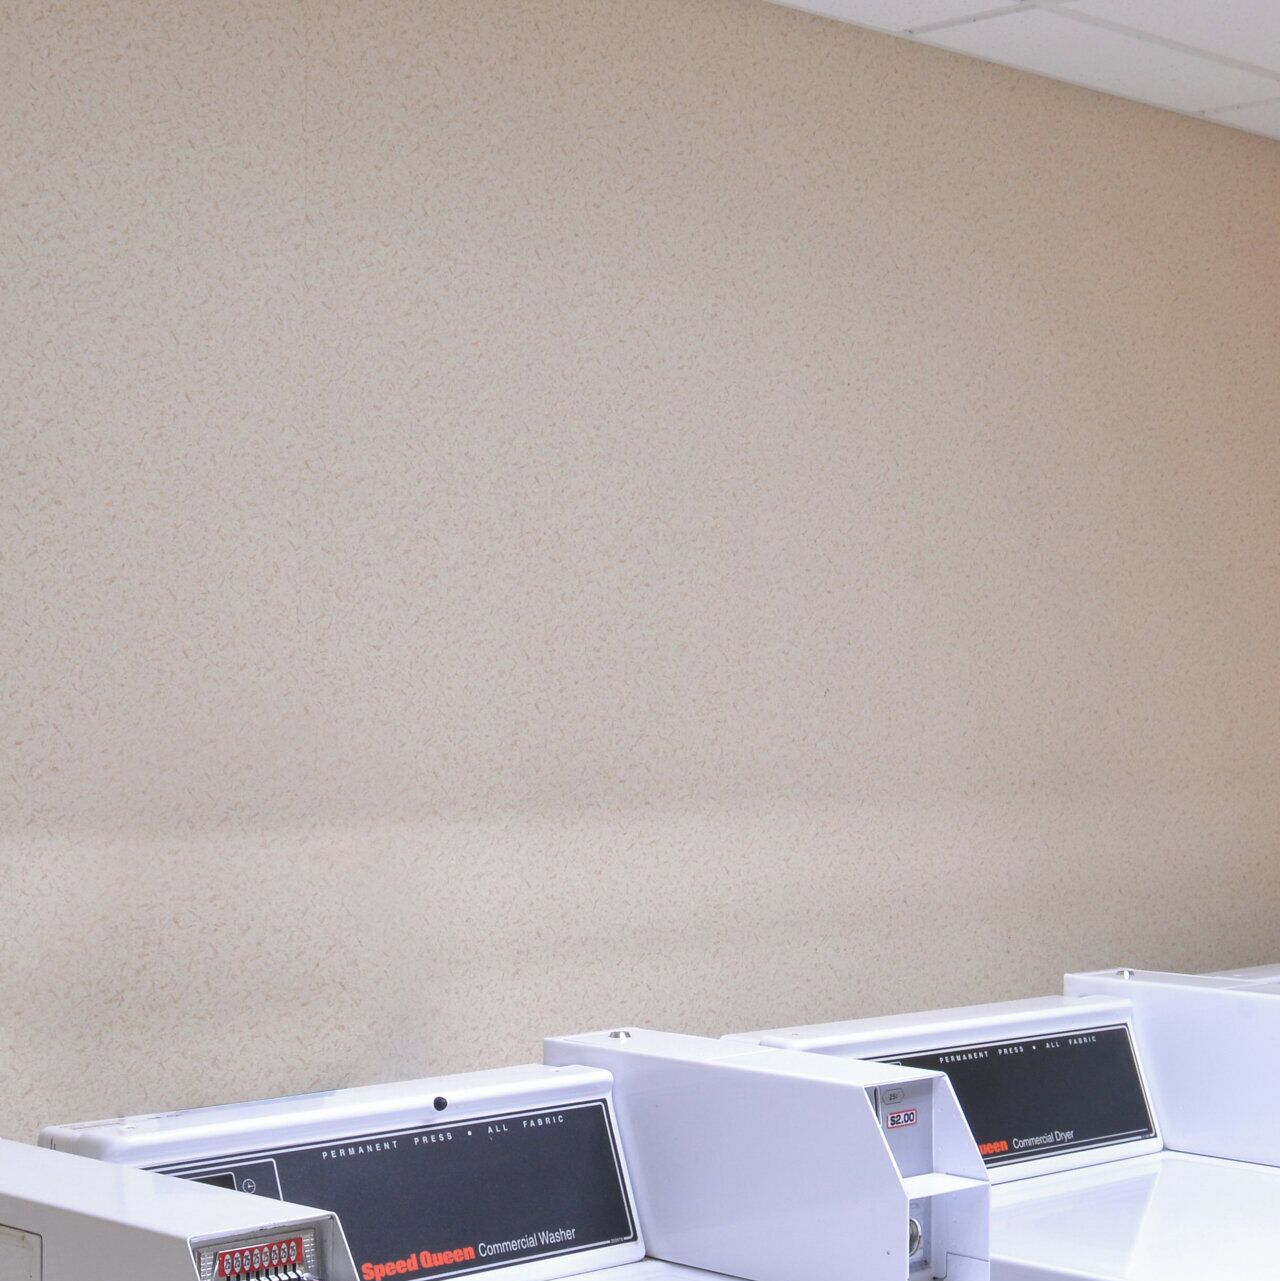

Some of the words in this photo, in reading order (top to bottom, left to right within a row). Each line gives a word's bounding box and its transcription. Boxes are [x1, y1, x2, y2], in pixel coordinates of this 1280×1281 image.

[939, 1050, 988, 1064] PERMANENT
[998, 1045, 1024, 1056] PRESS
[1045, 1041, 1060, 1049] ALL
[1068, 1036, 1097, 1046] FABRIC
[890, 1112, 915, 1126] $2.00
[322, 1140, 399, 1160] PERMANENT
[414, 1132, 453, 1146] PRESS
[487, 1123, 509, 1135] ALL
[522, 1115, 565, 1128] FABRIC
[978, 1140, 1009, 1155] ueen
[1012, 1132, 1054, 1149] Commercial
[1054, 1130, 1074, 1143] Dryer
[420, 1245, 476, 1269] Queen
[478, 1231, 538, 1258] Commercial
[538, 1227, 576, 1246] Washer
